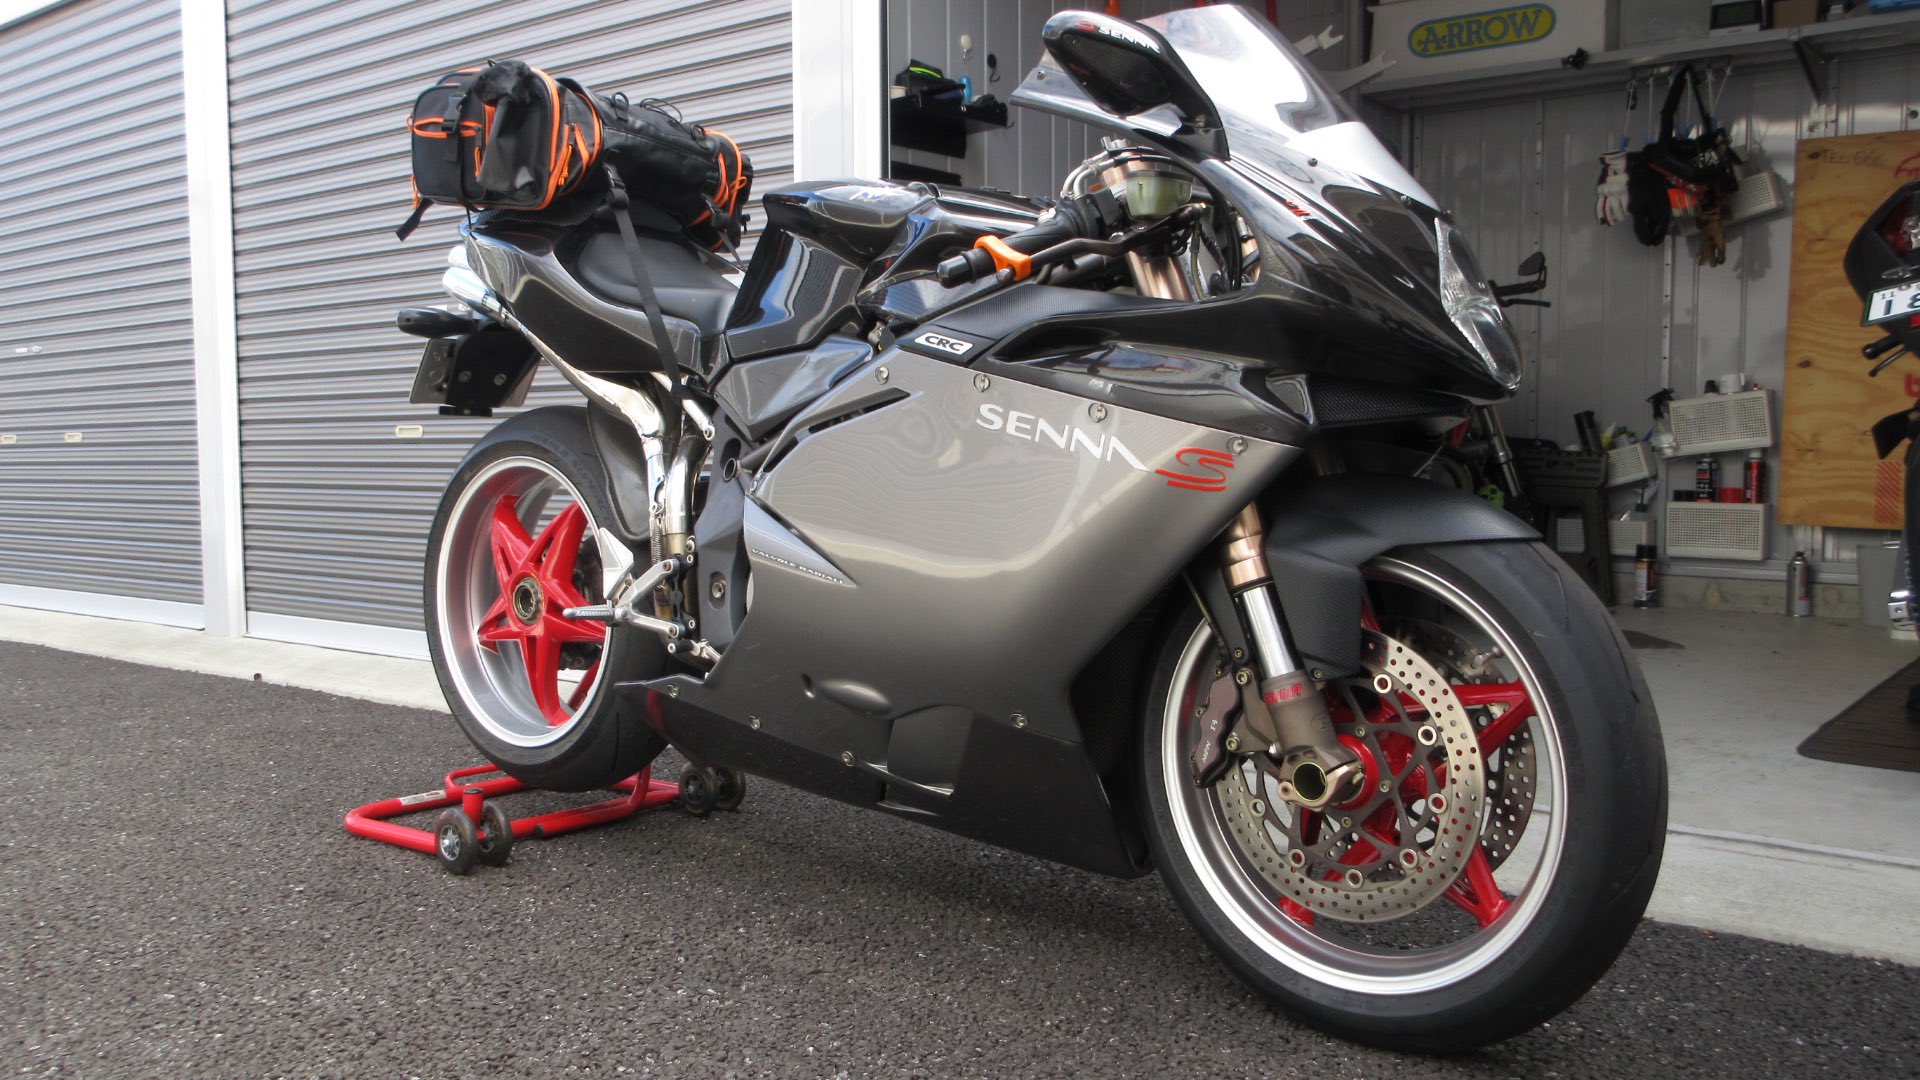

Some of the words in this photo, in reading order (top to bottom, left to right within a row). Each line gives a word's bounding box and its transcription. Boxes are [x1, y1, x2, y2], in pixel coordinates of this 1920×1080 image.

[1098, 25, 1160, 54] SENNA
[1417, 9, 1543, 52] ARROW
[924, 335, 964, 352] CRC
[975, 403, 1149, 472] SENNA
[751, 547, 797, 569] VALVOLE
